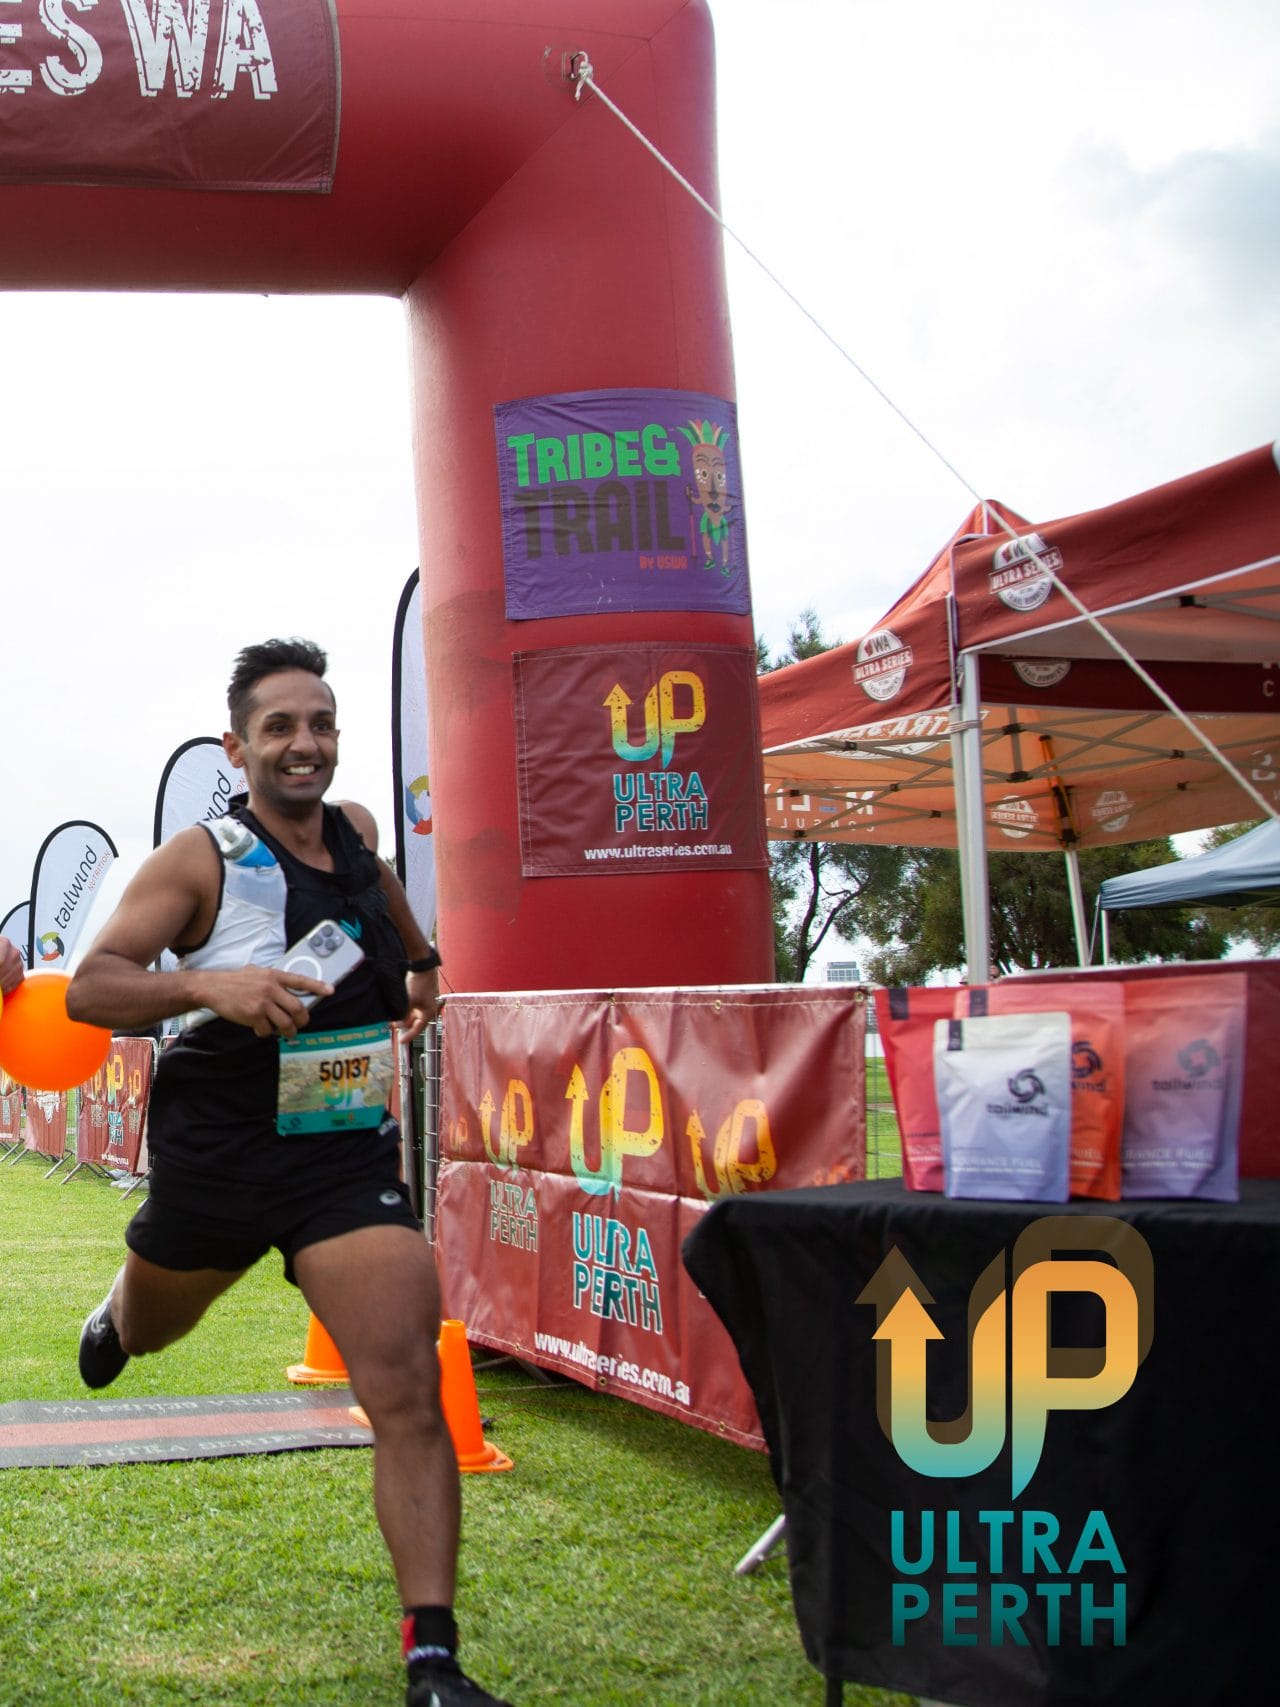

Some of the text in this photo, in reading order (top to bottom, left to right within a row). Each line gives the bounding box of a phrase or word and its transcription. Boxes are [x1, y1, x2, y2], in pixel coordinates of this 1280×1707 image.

[123, 0, 279, 101] WA
[512, 480, 686, 560] TRAIL
[639, 555, 655, 570] BY
[613, 771, 708, 804] ULTRA
[614, 801, 709, 833] PERTH
[87, 850, 112, 892] NUTRITION
[584, 842, 733, 861] www.ultraseries.com.au
[54, 844, 98, 930] tailwind
[320, 1055, 371, 1082] 50137
[490, 1179, 539, 1221] ULTRA
[490, 1211, 539, 1253] PERTH
[573, 1260, 664, 1336] PERTH
